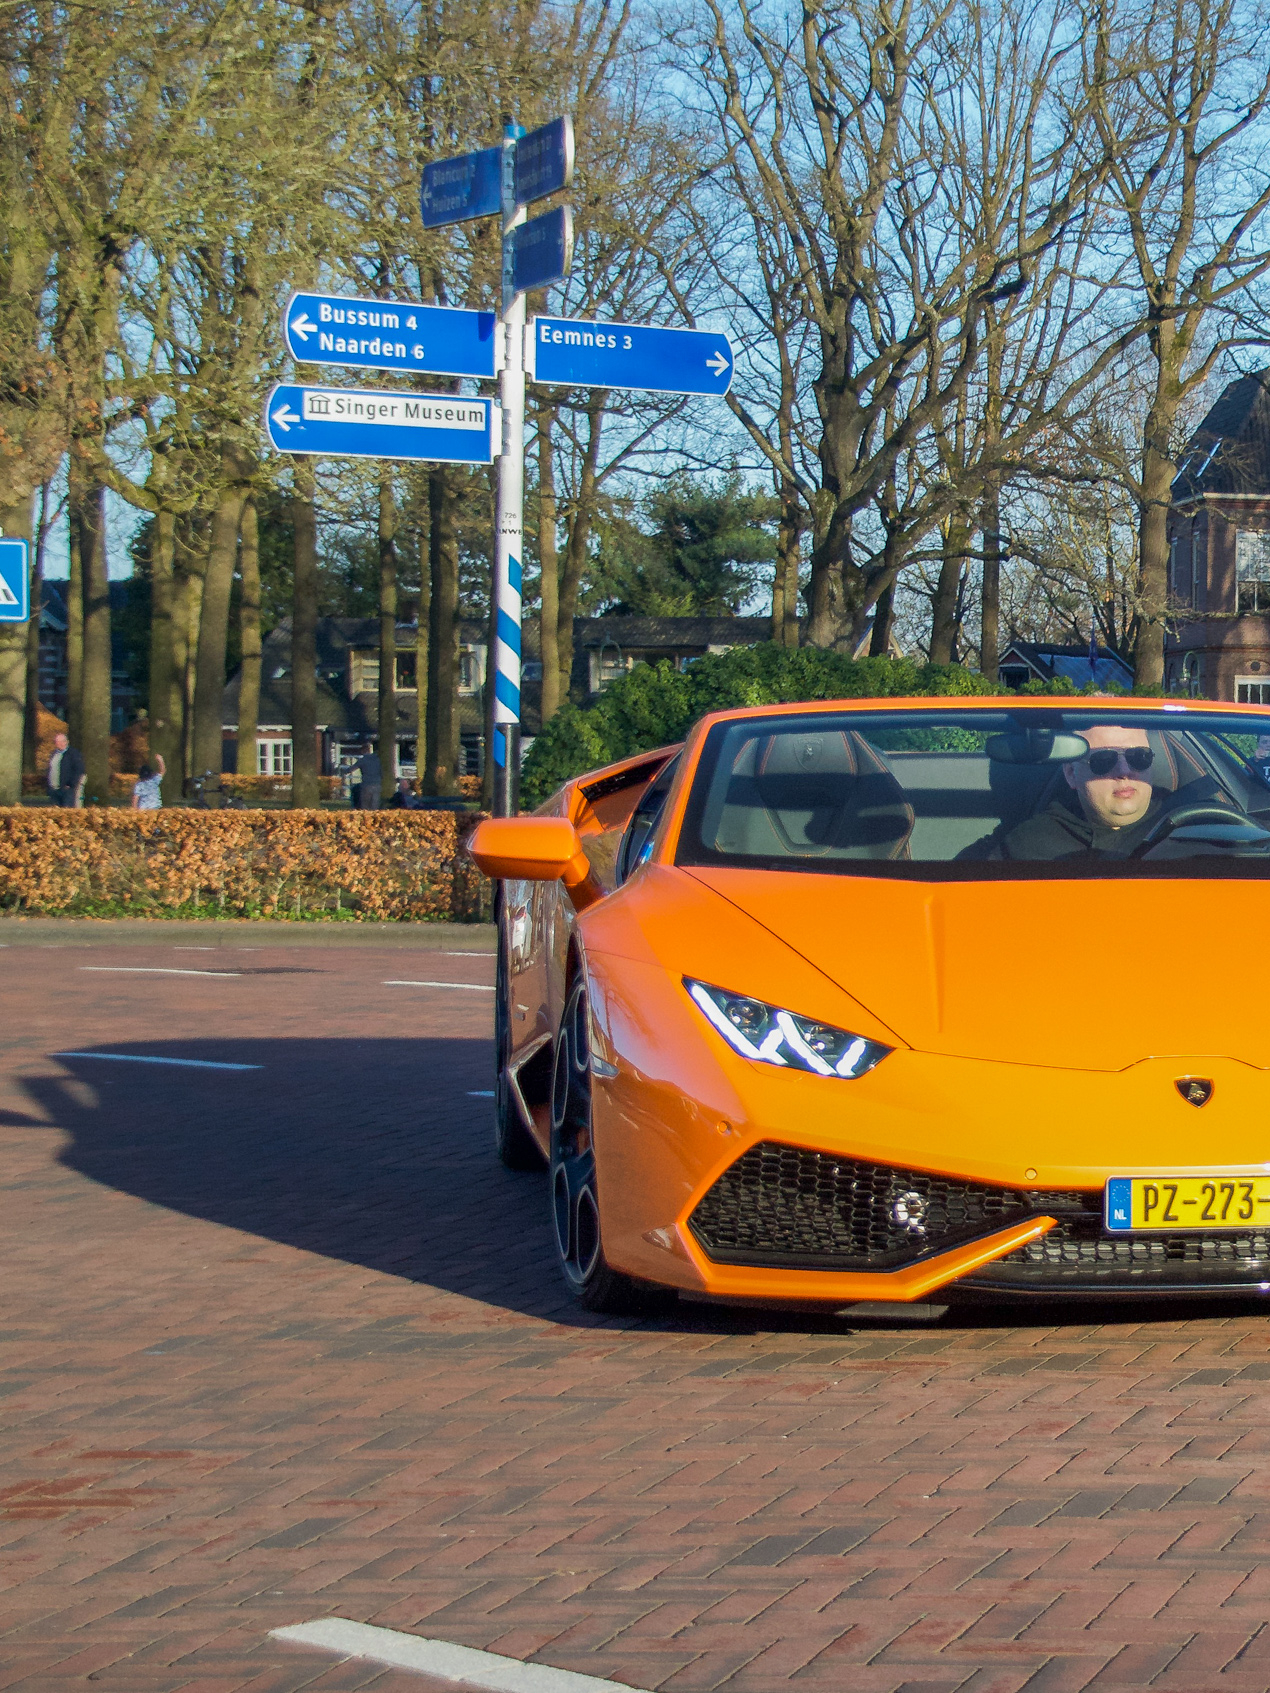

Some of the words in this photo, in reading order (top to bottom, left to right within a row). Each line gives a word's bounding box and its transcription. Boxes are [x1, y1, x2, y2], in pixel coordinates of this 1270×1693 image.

[319, 303, 400, 329] Bussum
[405, 314, 418, 331] 4
[319, 332, 406, 358] Naarden
[412, 344, 425, 360] 6
[540, 324, 617, 349] Eemnes
[622, 335, 633, 350] 3
[335, 398, 398, 420] Singer
[405, 402, 484, 423] Museum
[1114, 1208, 1127, 1220] NL
